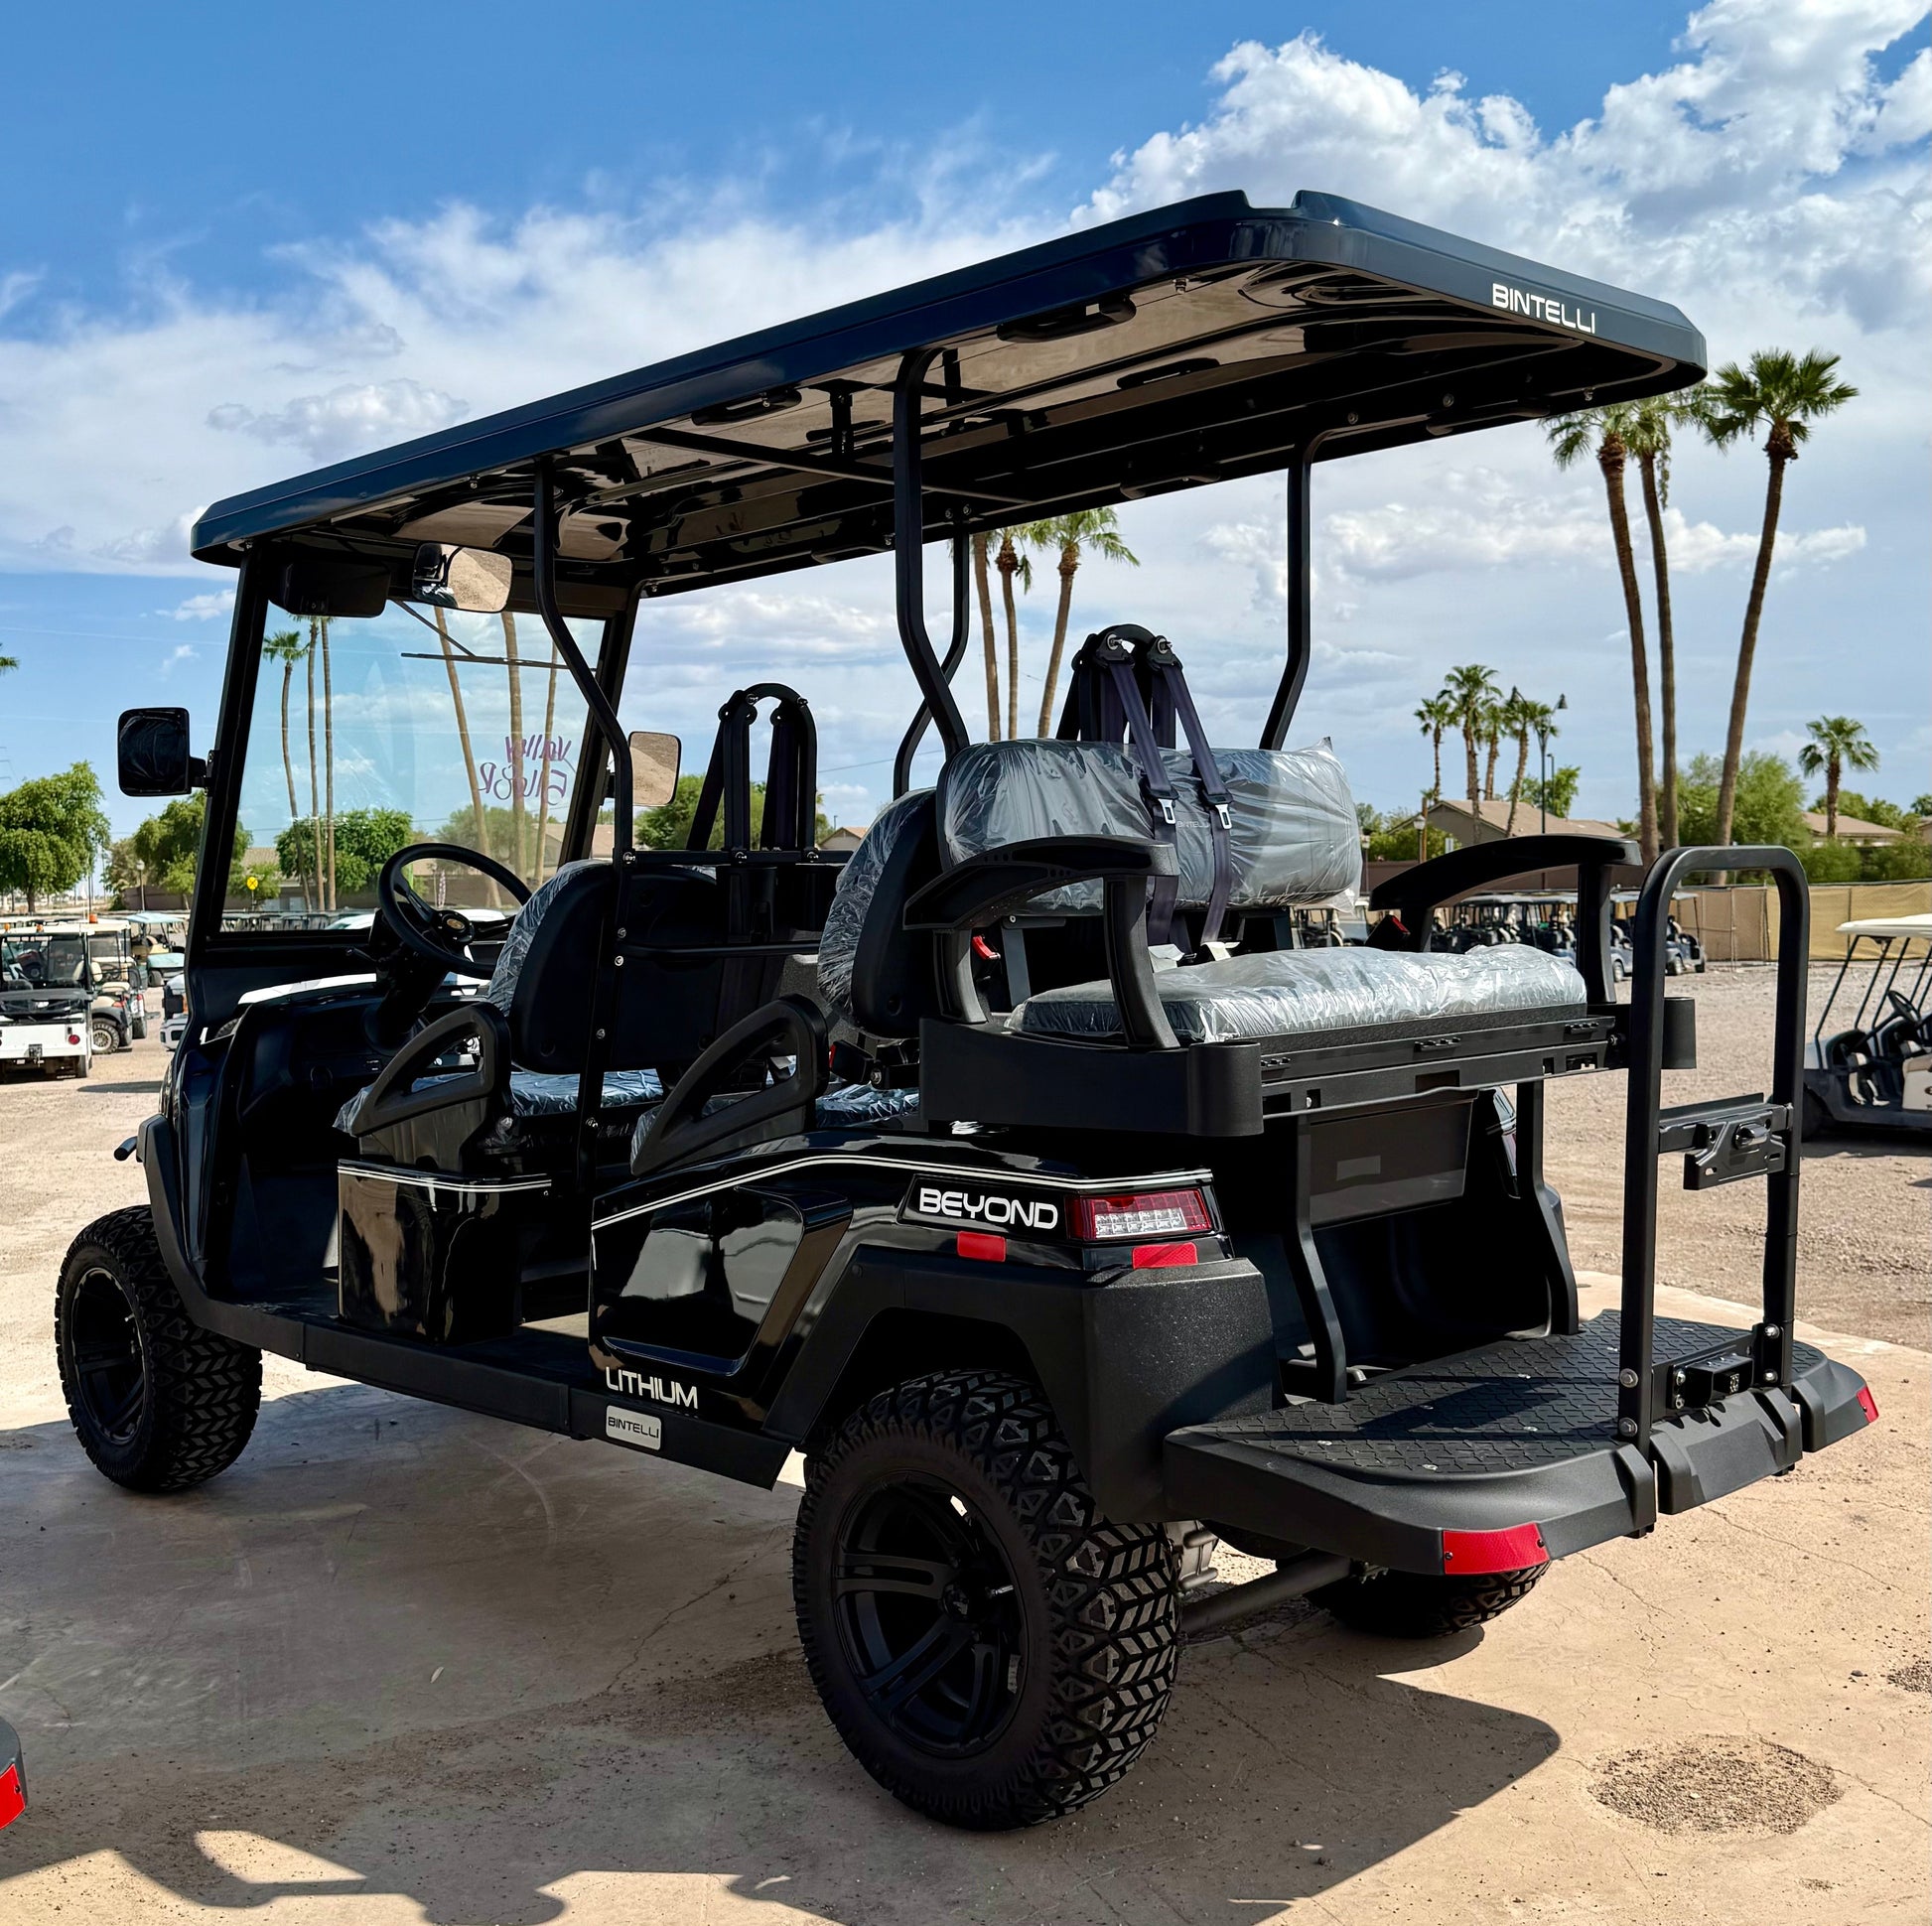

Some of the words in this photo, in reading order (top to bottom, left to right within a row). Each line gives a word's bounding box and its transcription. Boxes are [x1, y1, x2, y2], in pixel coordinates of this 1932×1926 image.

[1492, 283, 1595, 335] BINTELLI
[919, 1187, 1058, 1230] BEYOND
[606, 1366, 699, 1410] LITHIUM
[608, 1416, 659, 1439] BINTELLI
